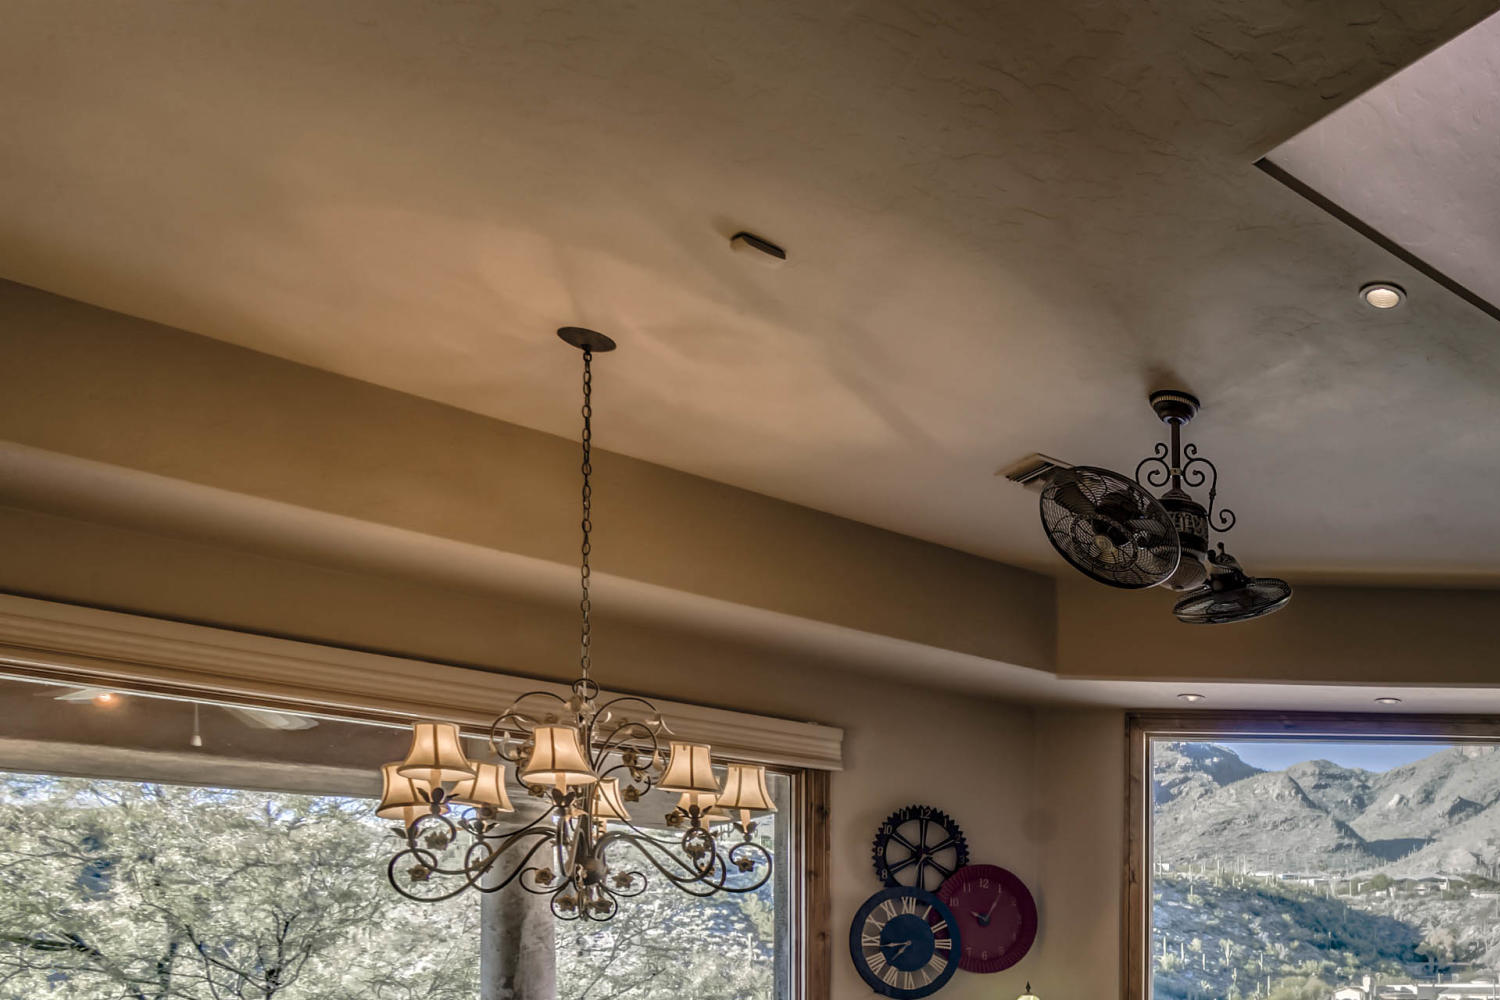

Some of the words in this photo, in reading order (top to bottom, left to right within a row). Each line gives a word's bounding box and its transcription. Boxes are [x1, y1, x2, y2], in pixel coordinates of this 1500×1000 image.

[920, 808, 931, 820] 12
[876, 847, 884, 857] 9
[881, 868, 888, 879] 8
[979, 877, 990, 889] 12
[901, 896, 917, 915] XII
[949, 896, 960, 907] 10
[879, 899, 898, 921] XI
[866, 914, 886, 931] X
[930, 919, 948, 934] II
[861, 934, 881, 947] IX
[934, 938, 952, 951] III
